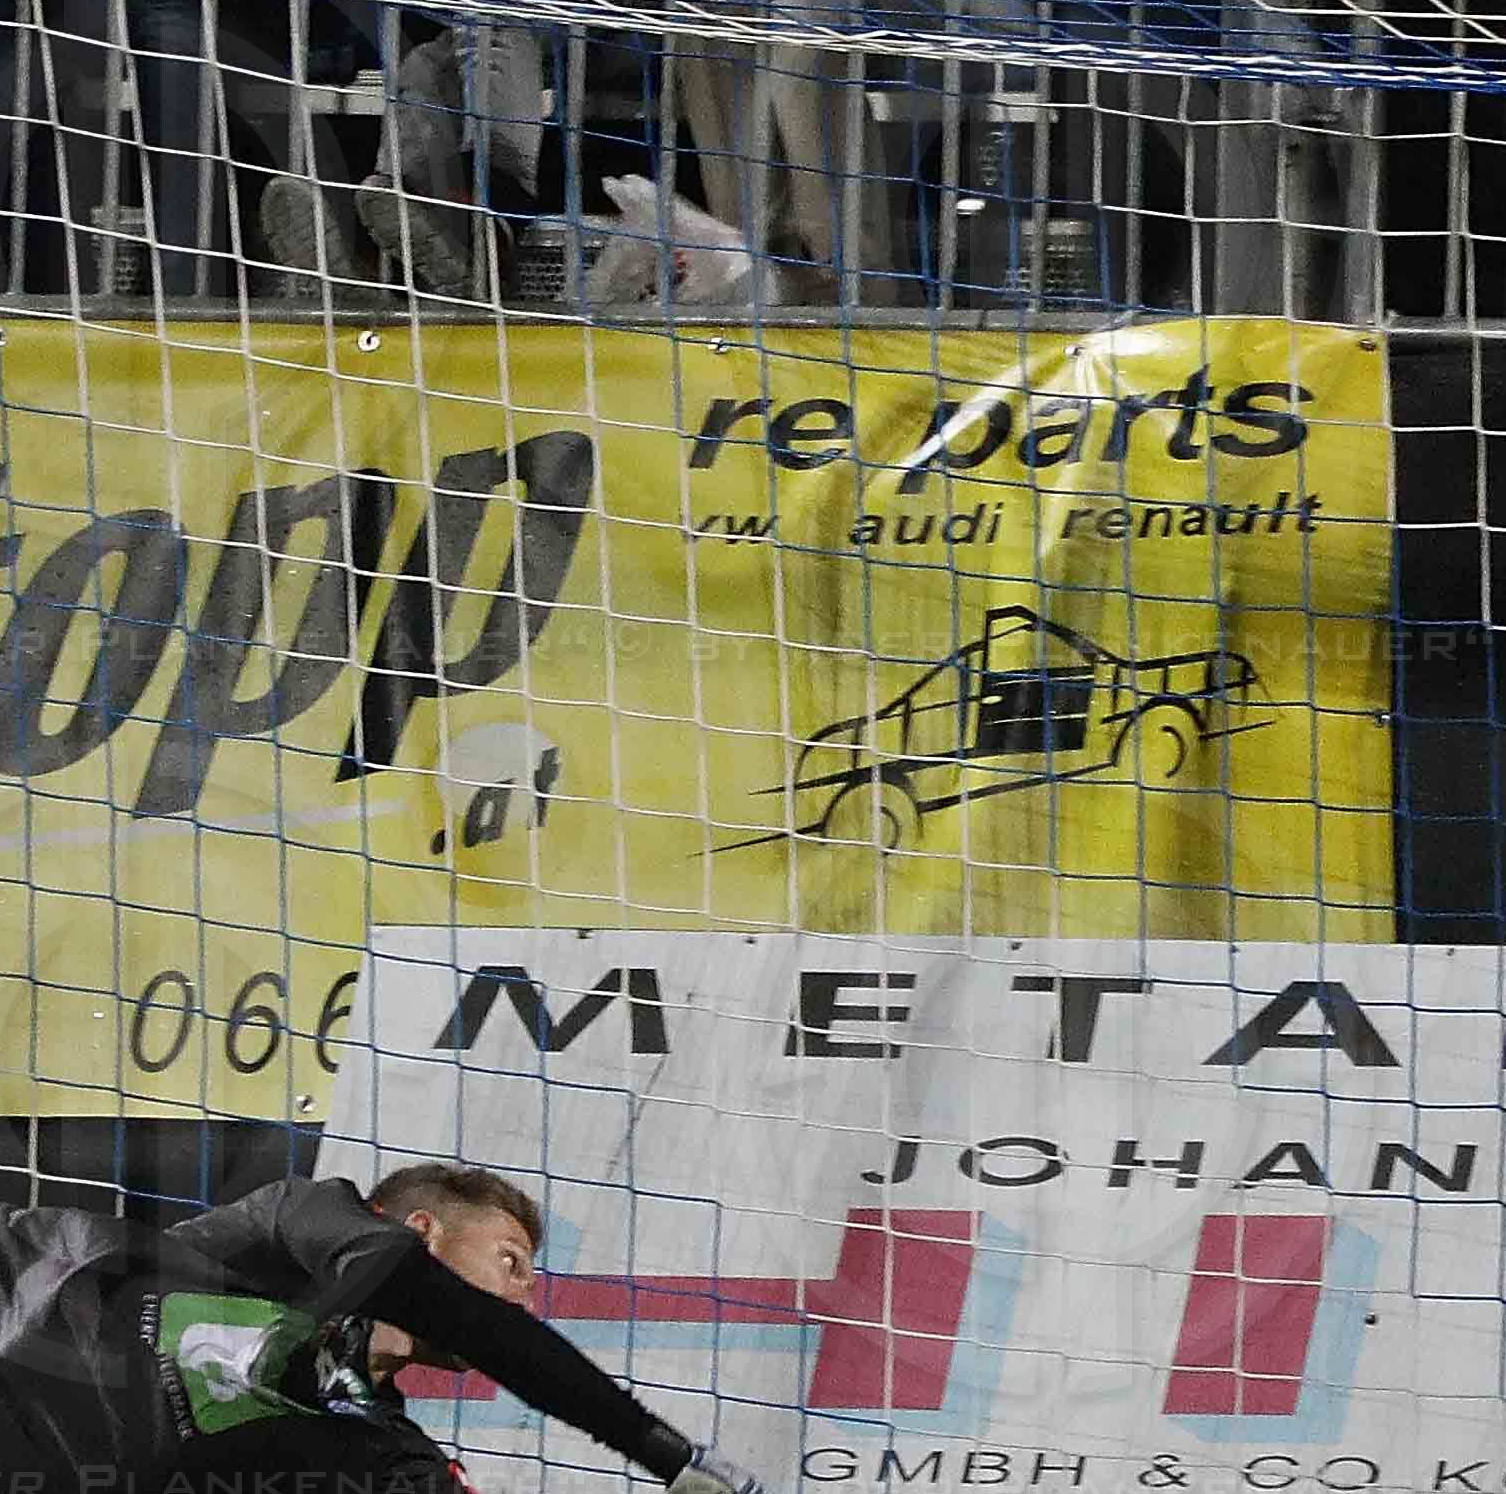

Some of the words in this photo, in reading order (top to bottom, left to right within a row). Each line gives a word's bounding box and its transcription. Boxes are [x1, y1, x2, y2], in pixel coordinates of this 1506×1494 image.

[690, 396, 855, 470] re
[898, 364, 1315, 495] parts
[849, 502, 1003, 546] audi
[1062, 491, 1324, 541] renault
[801, 1447, 1084, 1489] GMBH
[1139, 1454, 1191, 1489] &
[1244, 1455, 1381, 1492] CO
